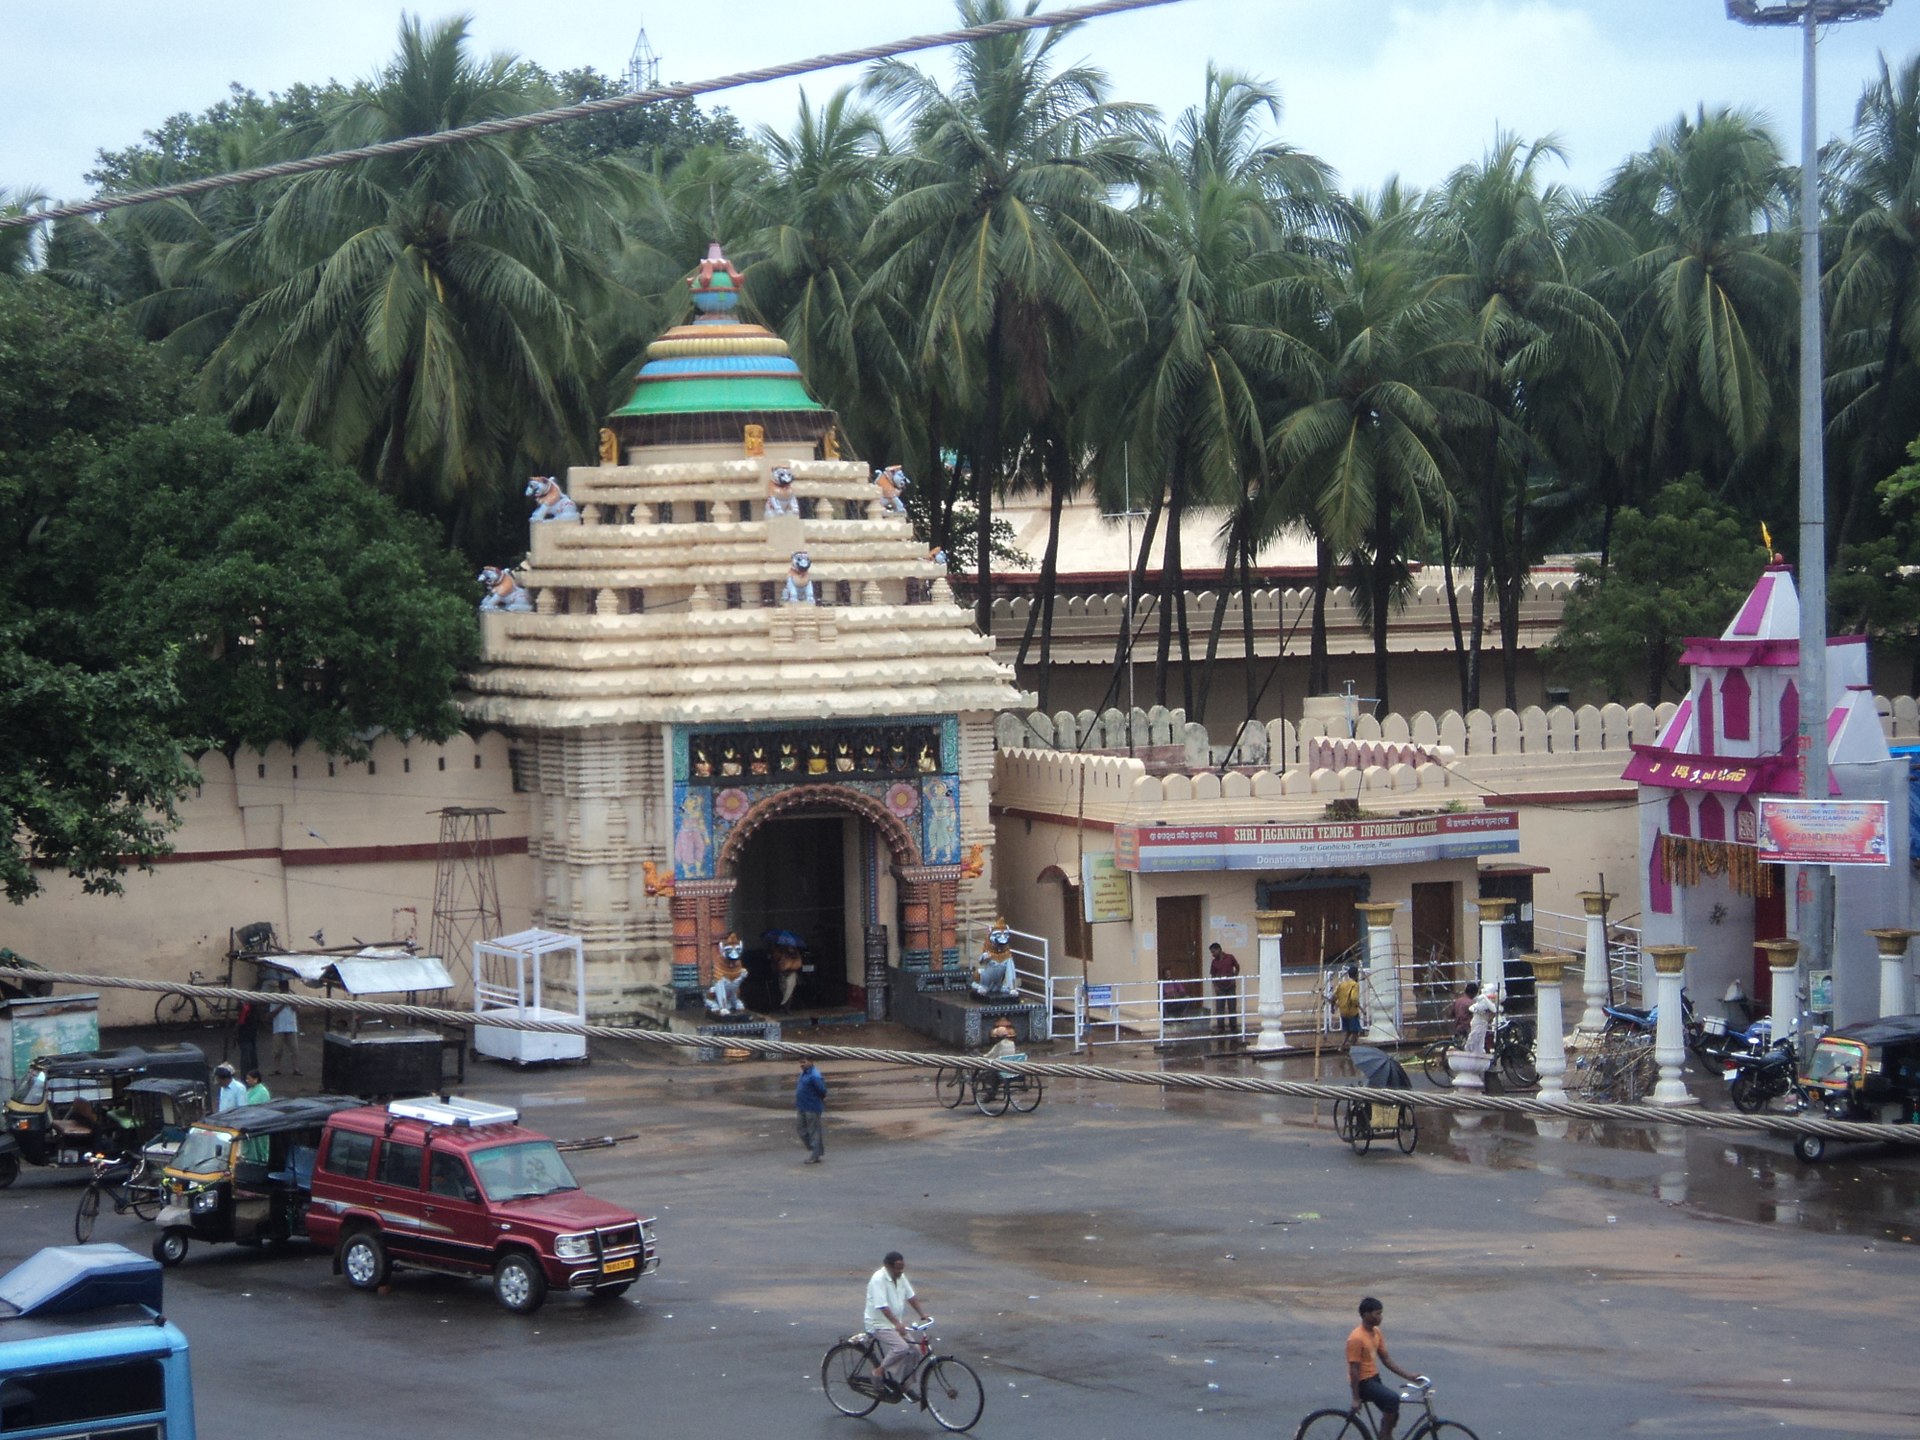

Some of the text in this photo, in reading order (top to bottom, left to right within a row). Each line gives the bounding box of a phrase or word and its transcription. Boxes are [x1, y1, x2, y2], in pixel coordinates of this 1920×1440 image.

[1234, 820, 1438, 844] SHRI JAGANNATH TEMPLE INFORMATION CENTRE
[1256, 855, 1296, 864] Donation
[1310, 854, 1324, 862] the
[1326, 853, 1355, 864] Temple
[1356, 852, 1376, 861] Fund
[1377, 850, 1411, 862] Accepted
